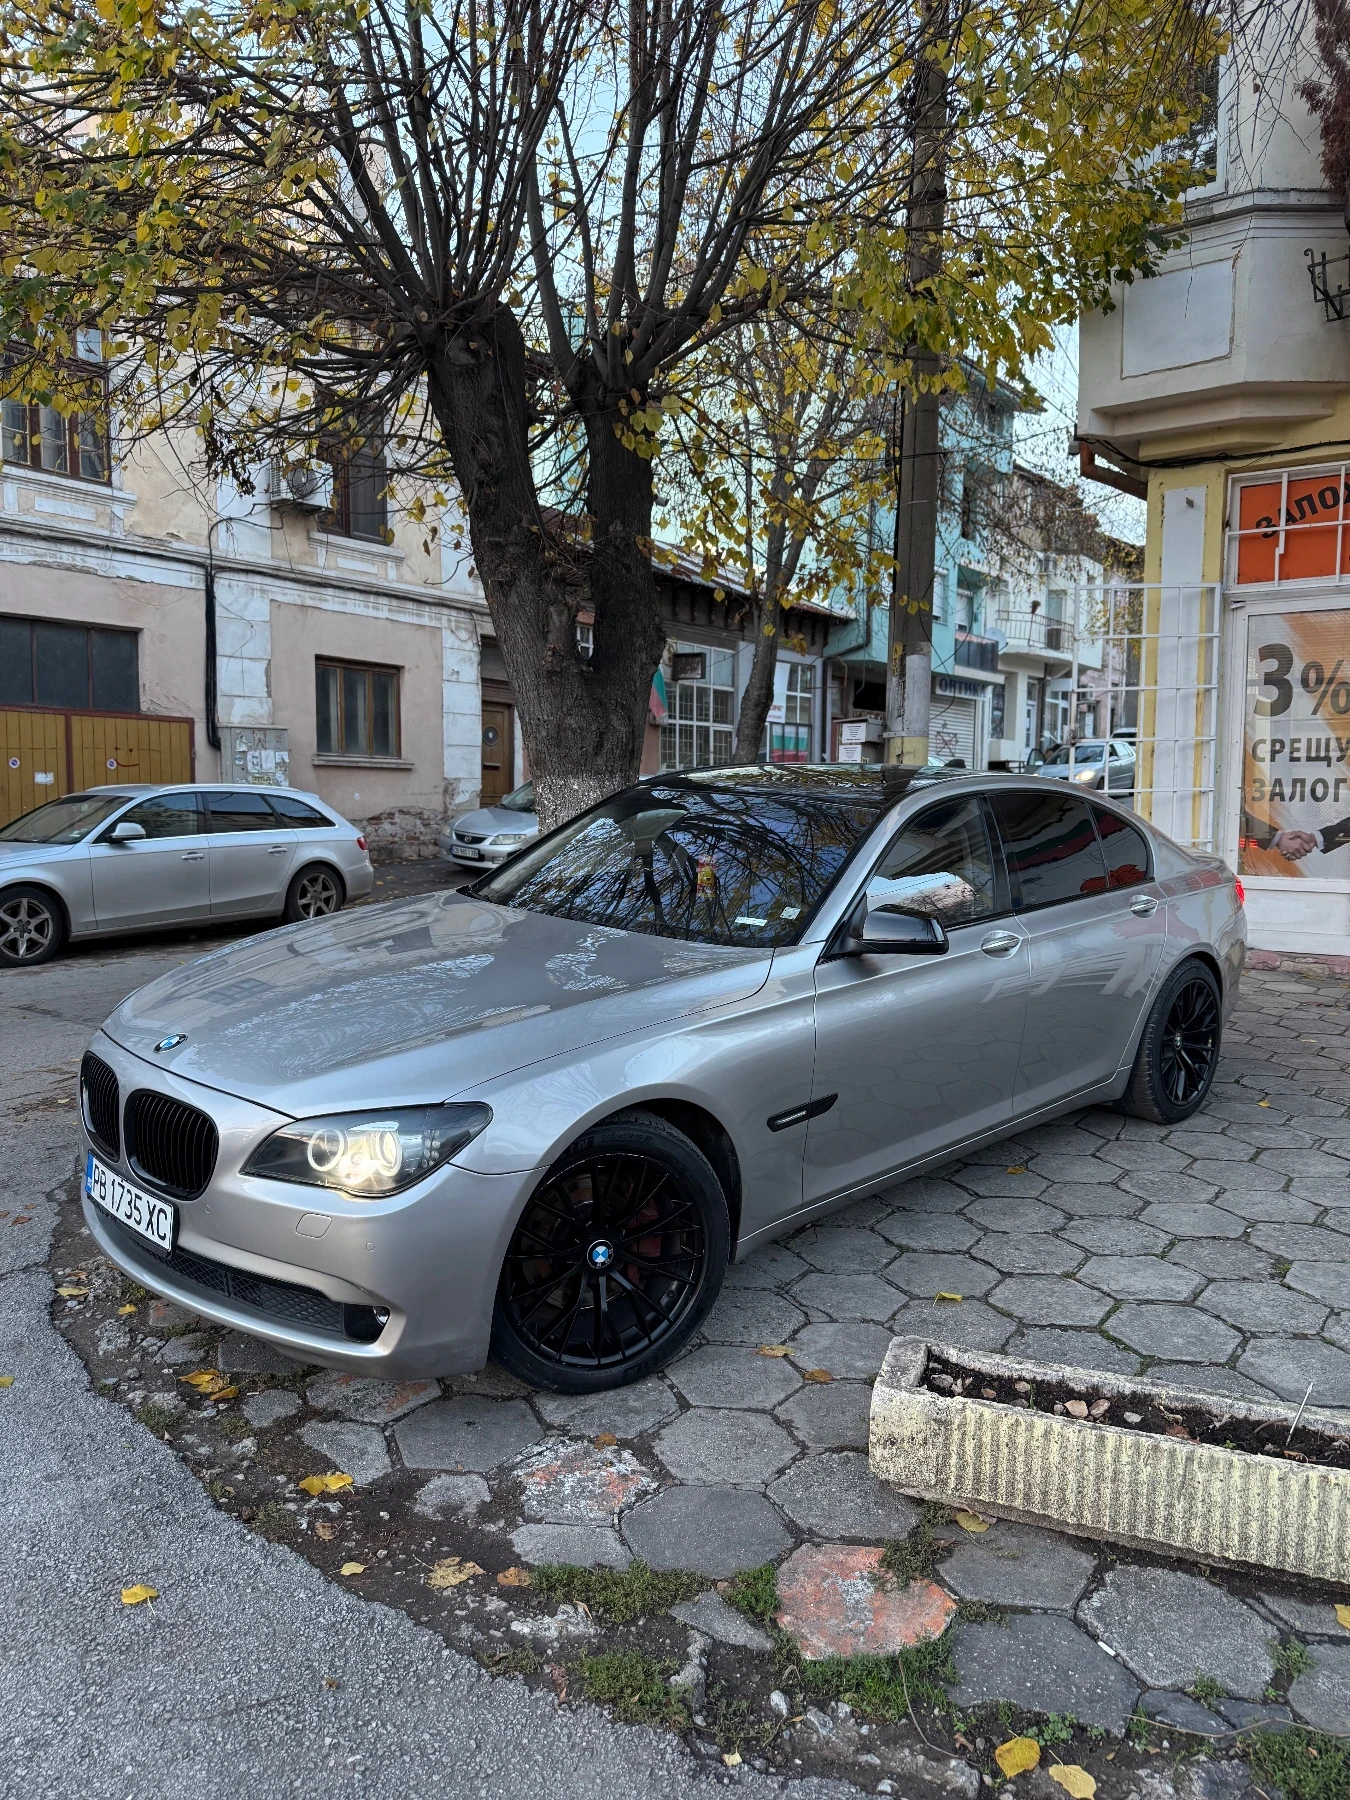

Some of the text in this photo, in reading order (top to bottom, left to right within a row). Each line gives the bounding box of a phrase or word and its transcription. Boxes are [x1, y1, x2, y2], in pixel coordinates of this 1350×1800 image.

[1255, 481, 1350, 539] ЗАЛО
[939, 677, 987, 698] ОПТИКА
[1253, 643, 1350, 717] 3%
[1252, 737, 1350, 768] СРЕЩУ
[1252, 777, 1347, 803] ЗАЛОГ
[93, 1163, 168, 1241] PB 1735 XC
